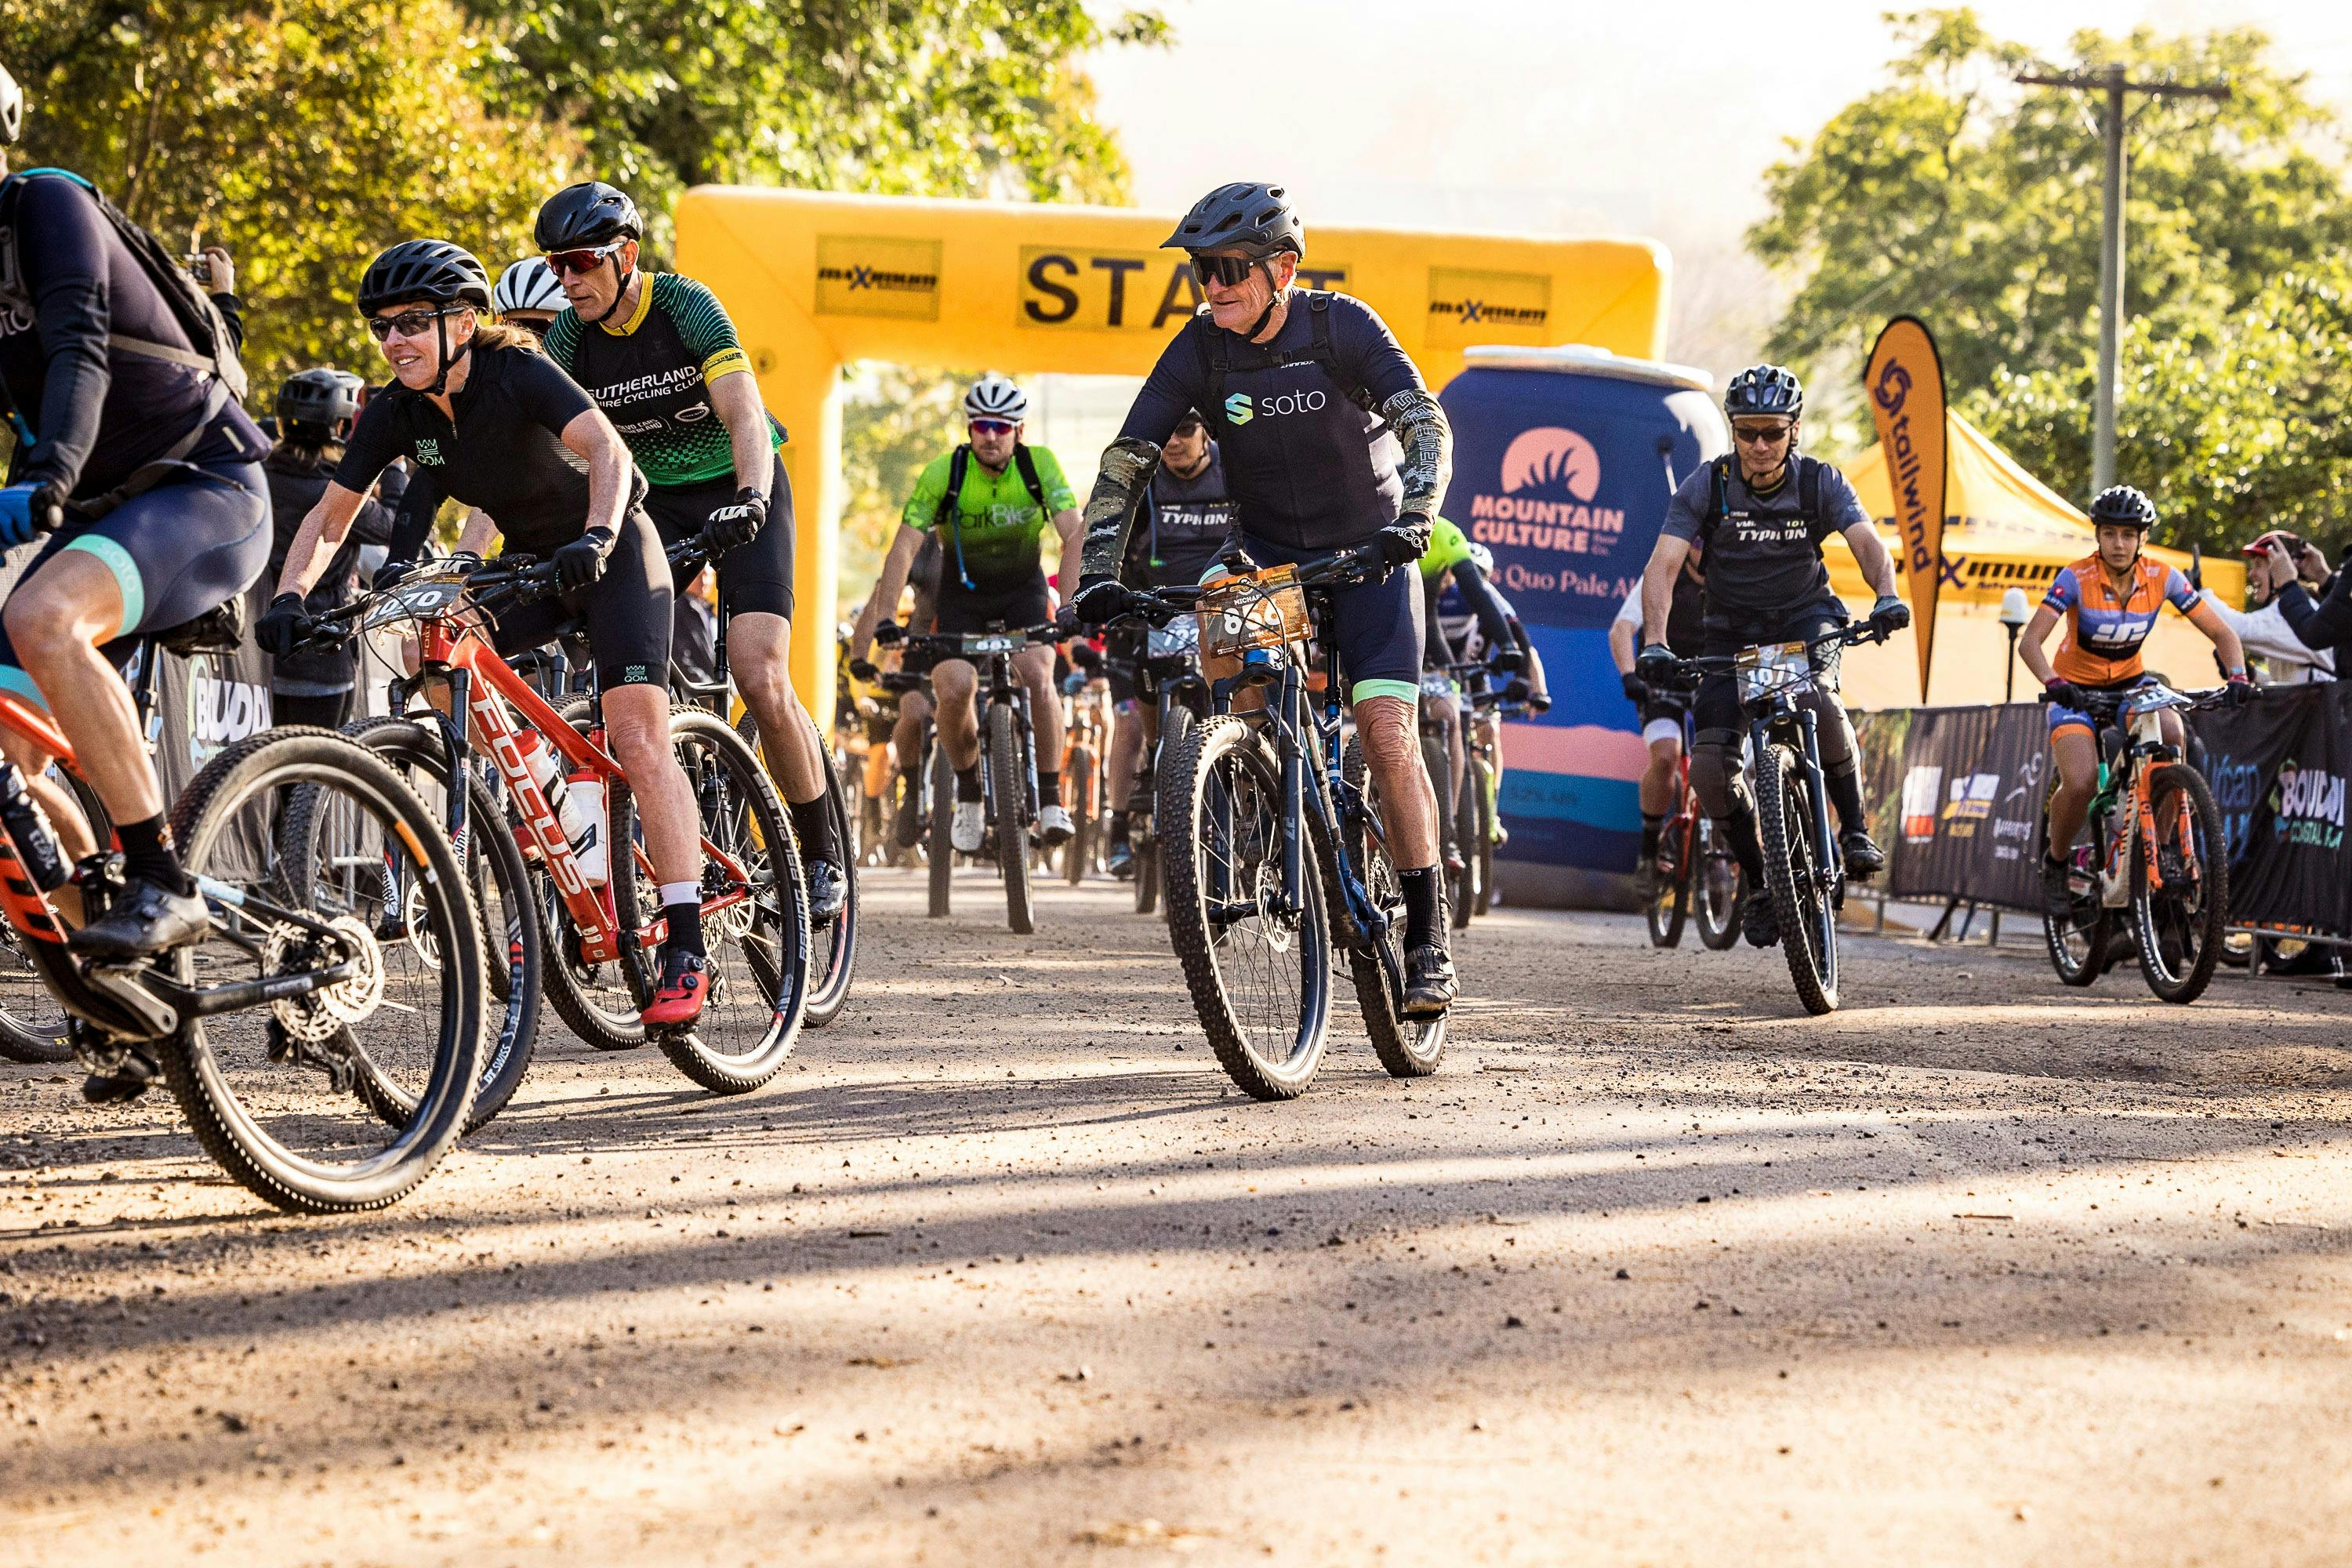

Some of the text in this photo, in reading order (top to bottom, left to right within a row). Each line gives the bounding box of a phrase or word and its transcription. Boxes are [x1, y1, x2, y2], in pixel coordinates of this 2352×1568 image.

[587, 366, 696, 399] SUTHERLAND
[623, 387, 671, 404] CYCLING
[674, 372, 703, 393] CLUB
[1261, 389, 1327, 416] soto
[416, 454, 445, 466] QOM
[1892, 414, 1932, 573] tailwind
[1470, 494, 1625, 534] MOUNTAIN
[1472, 518, 1589, 554] CULTURE
[1505, 564, 1556, 592] Quo
[1559, 569, 1609, 598] Pale
[1611, 576, 1639, 600] Al
[364, 590, 443, 625] 1070
[1223, 597, 1285, 635] 856
[1747, 662, 1801, 689] 1071
[471, 698, 589, 896] FOCUS
[774, 814, 808, 963] RACING RALPH
[483, 1044, 511, 1086] DT SWISS
